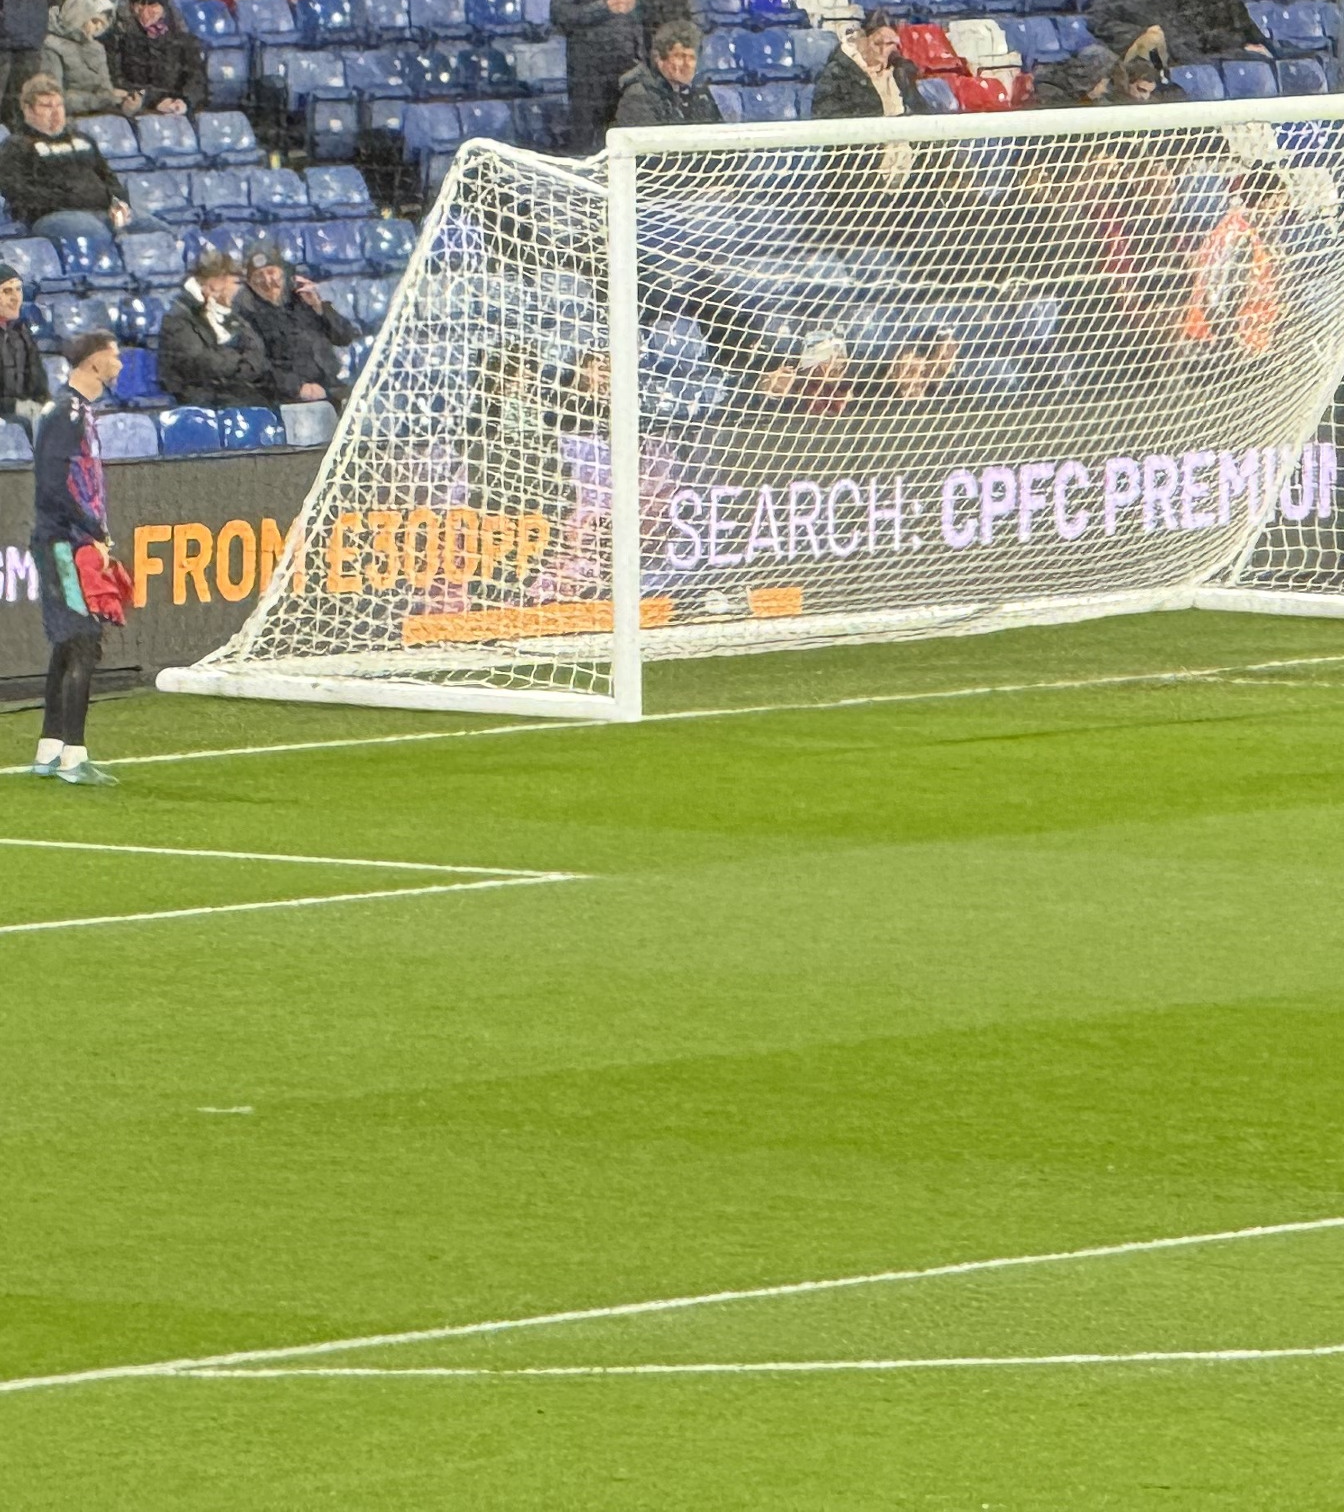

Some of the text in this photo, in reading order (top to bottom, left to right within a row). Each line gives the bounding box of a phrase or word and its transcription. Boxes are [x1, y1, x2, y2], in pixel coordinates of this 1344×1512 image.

[133, 519, 303, 608] FROM
[666, 478, 922, 569] SEARCH:
[941, 462, 1089, 548] CPFC
